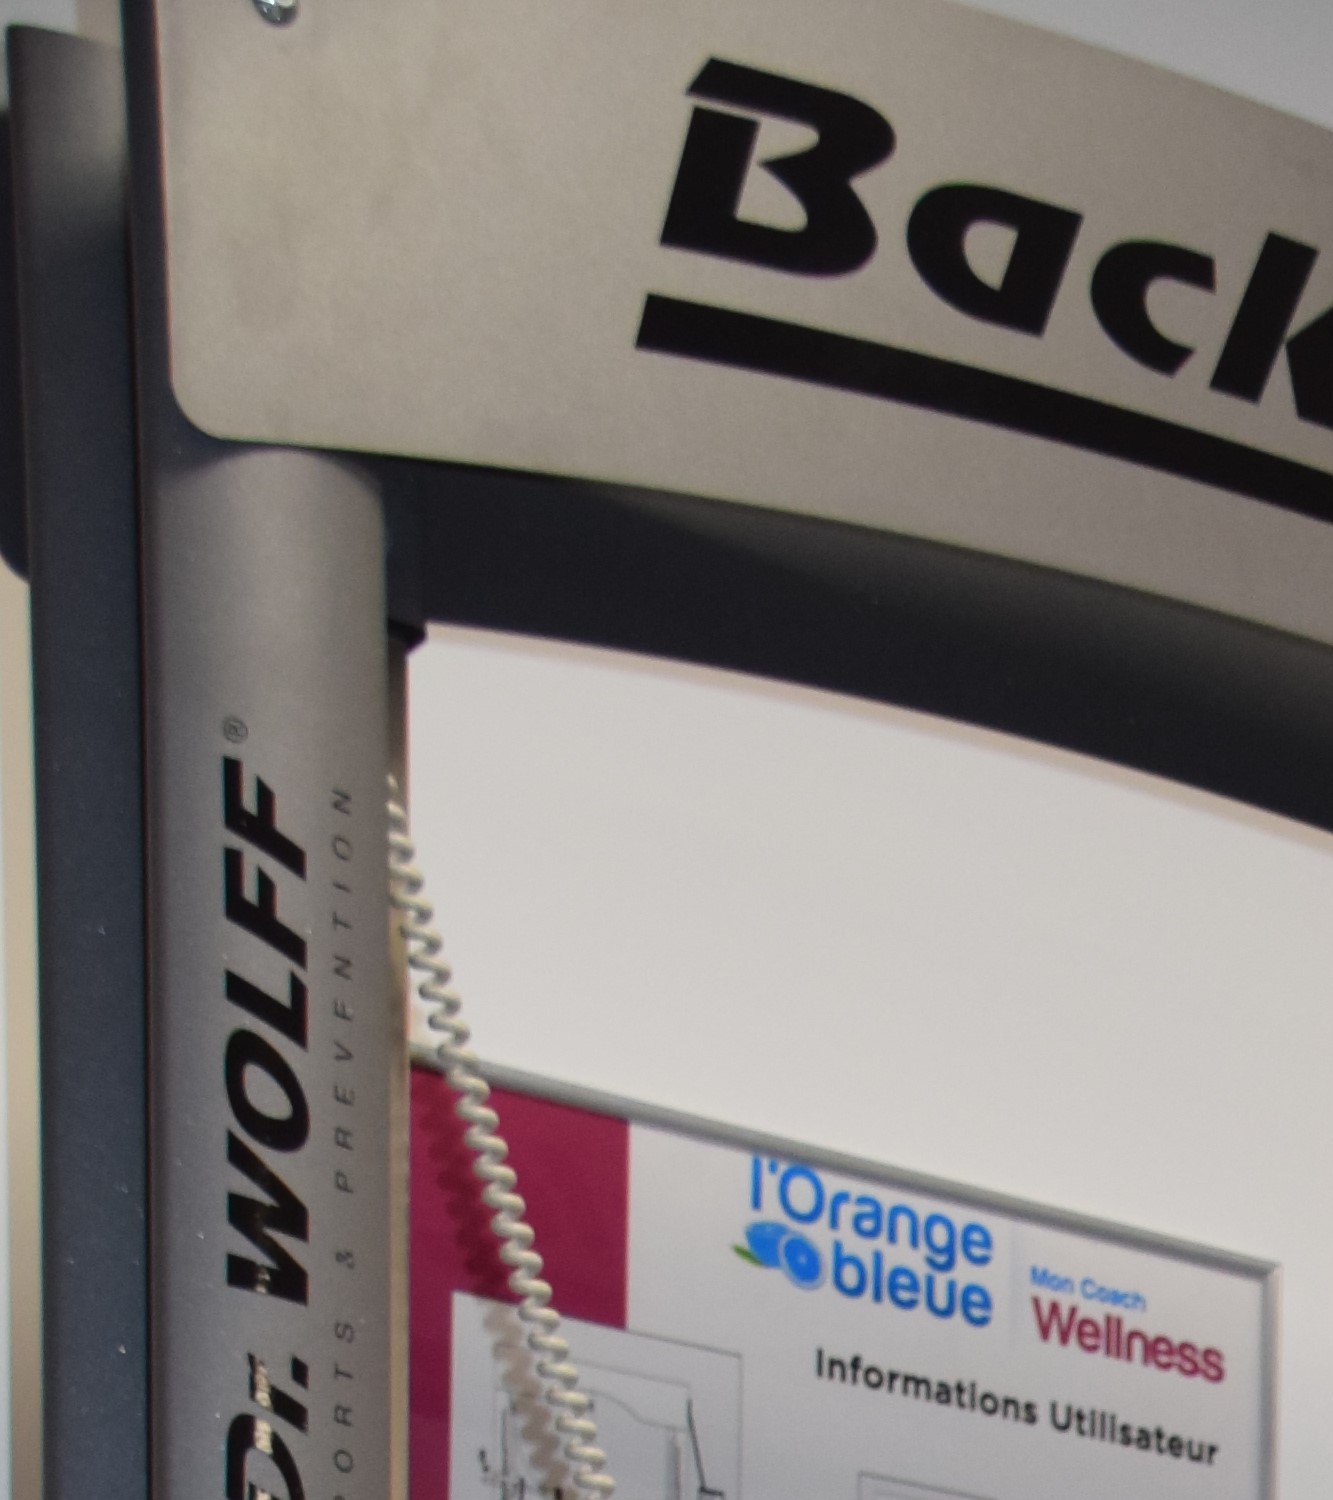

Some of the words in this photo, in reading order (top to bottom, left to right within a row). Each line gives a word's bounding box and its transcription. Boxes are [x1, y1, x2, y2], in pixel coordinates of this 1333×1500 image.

[330, 787, 358, 1197] PREVENTION
[333, 1249, 357, 1272] &
[831, 1241, 994, 1328] bleue
[1029, 1265, 1075, 1297] Mon
[1031, 1297, 1226, 1384] Wellness
[815, 1347, 1039, 1426] Informations
[1048, 1405, 1220, 1467] Utilisateur
